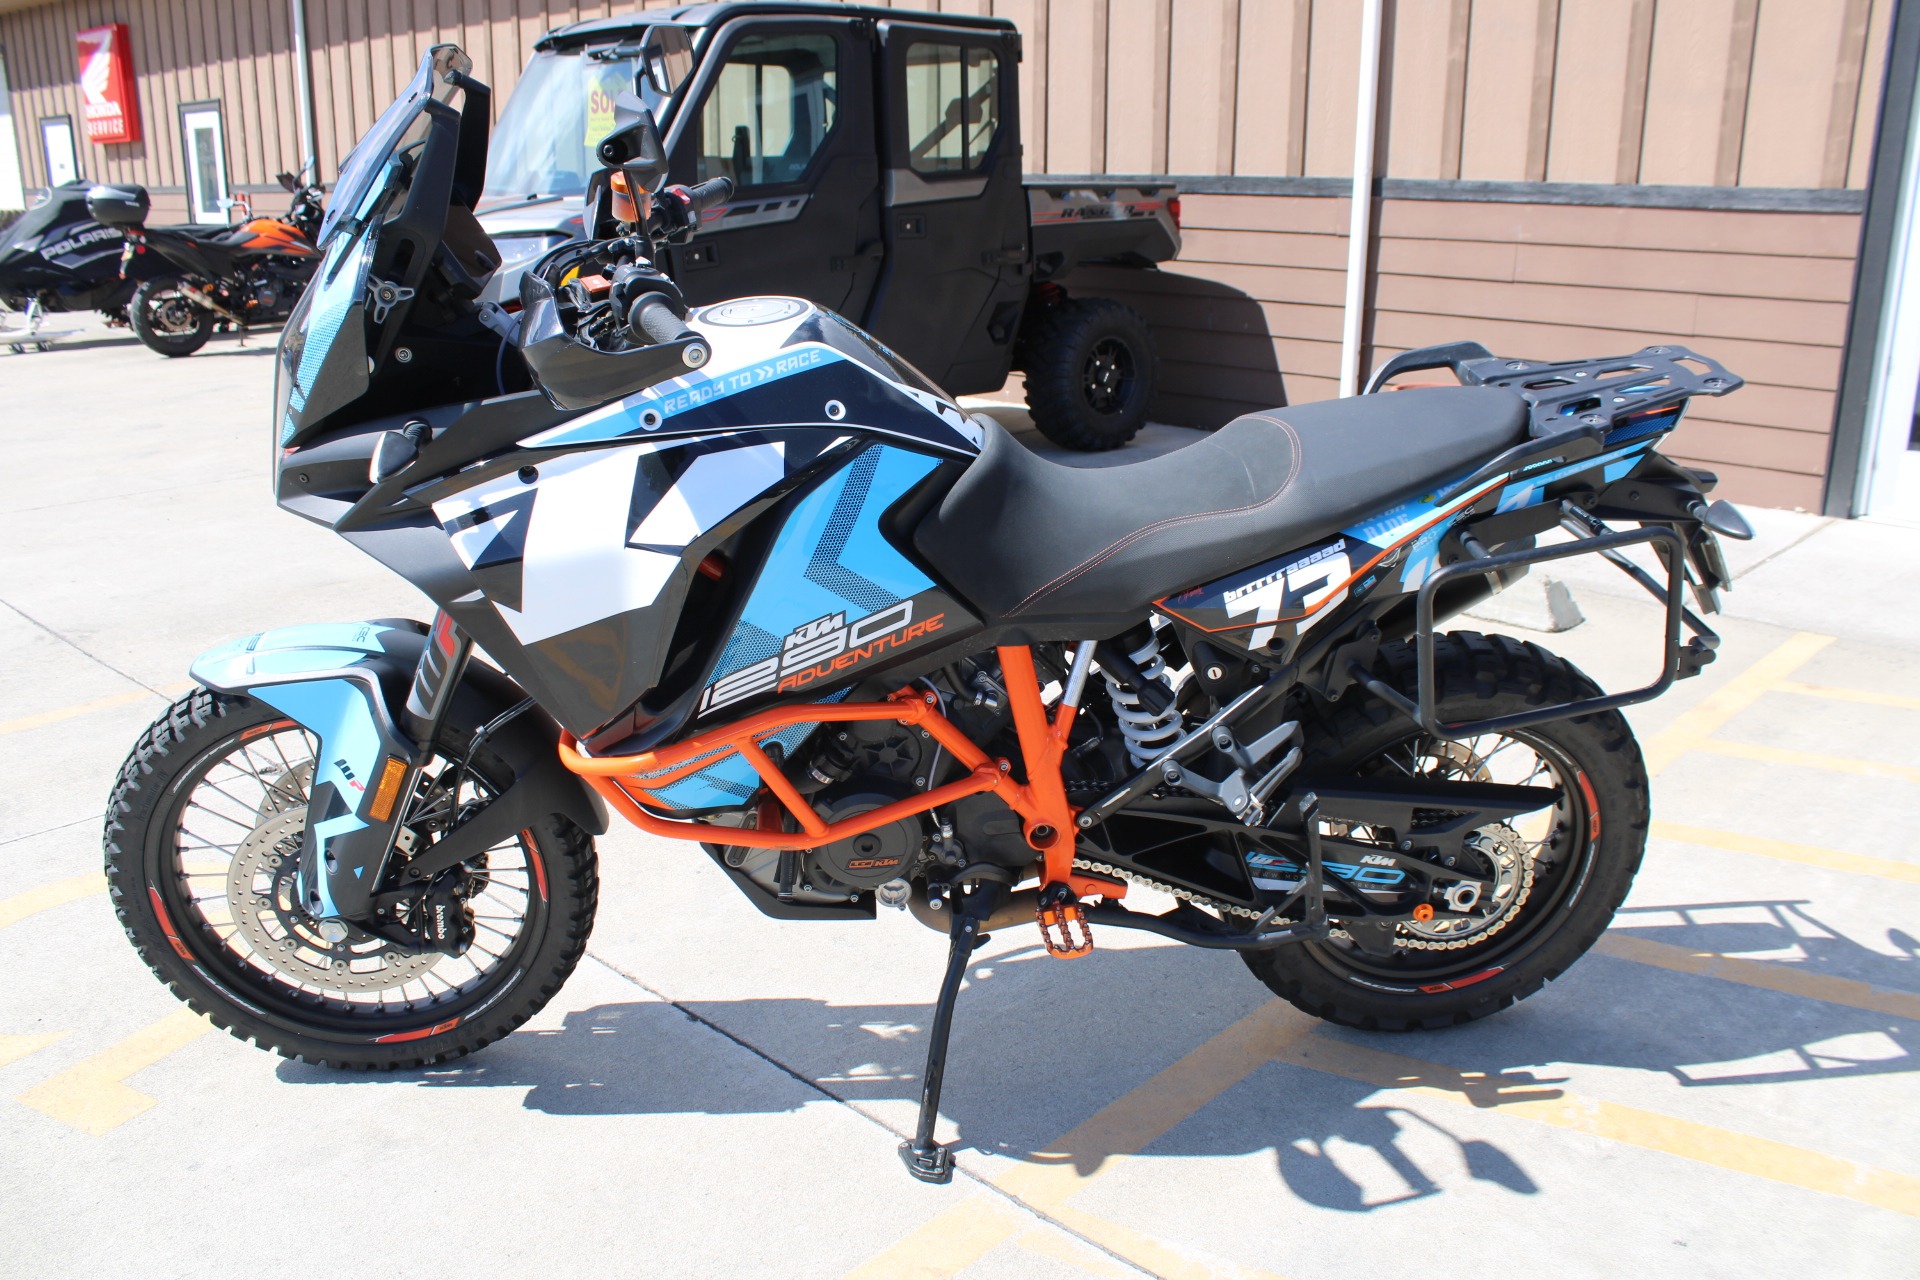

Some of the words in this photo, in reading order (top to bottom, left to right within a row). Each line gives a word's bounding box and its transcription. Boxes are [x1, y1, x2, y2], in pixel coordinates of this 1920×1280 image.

[87, 118, 124, 136] SERVICE
[40, 228, 123, 261] POLARIS
[664, 382, 725, 414] READY
[729, 371, 751, 389] TO
[776, 349, 821, 375] RACE
[784, 613, 846, 650] KTM
[697, 600, 914, 719] 1290
[777, 613, 945, 694] ADVENTURE
[1360, 854, 1398, 867] KTM
[436, 905, 447, 939] brembo
